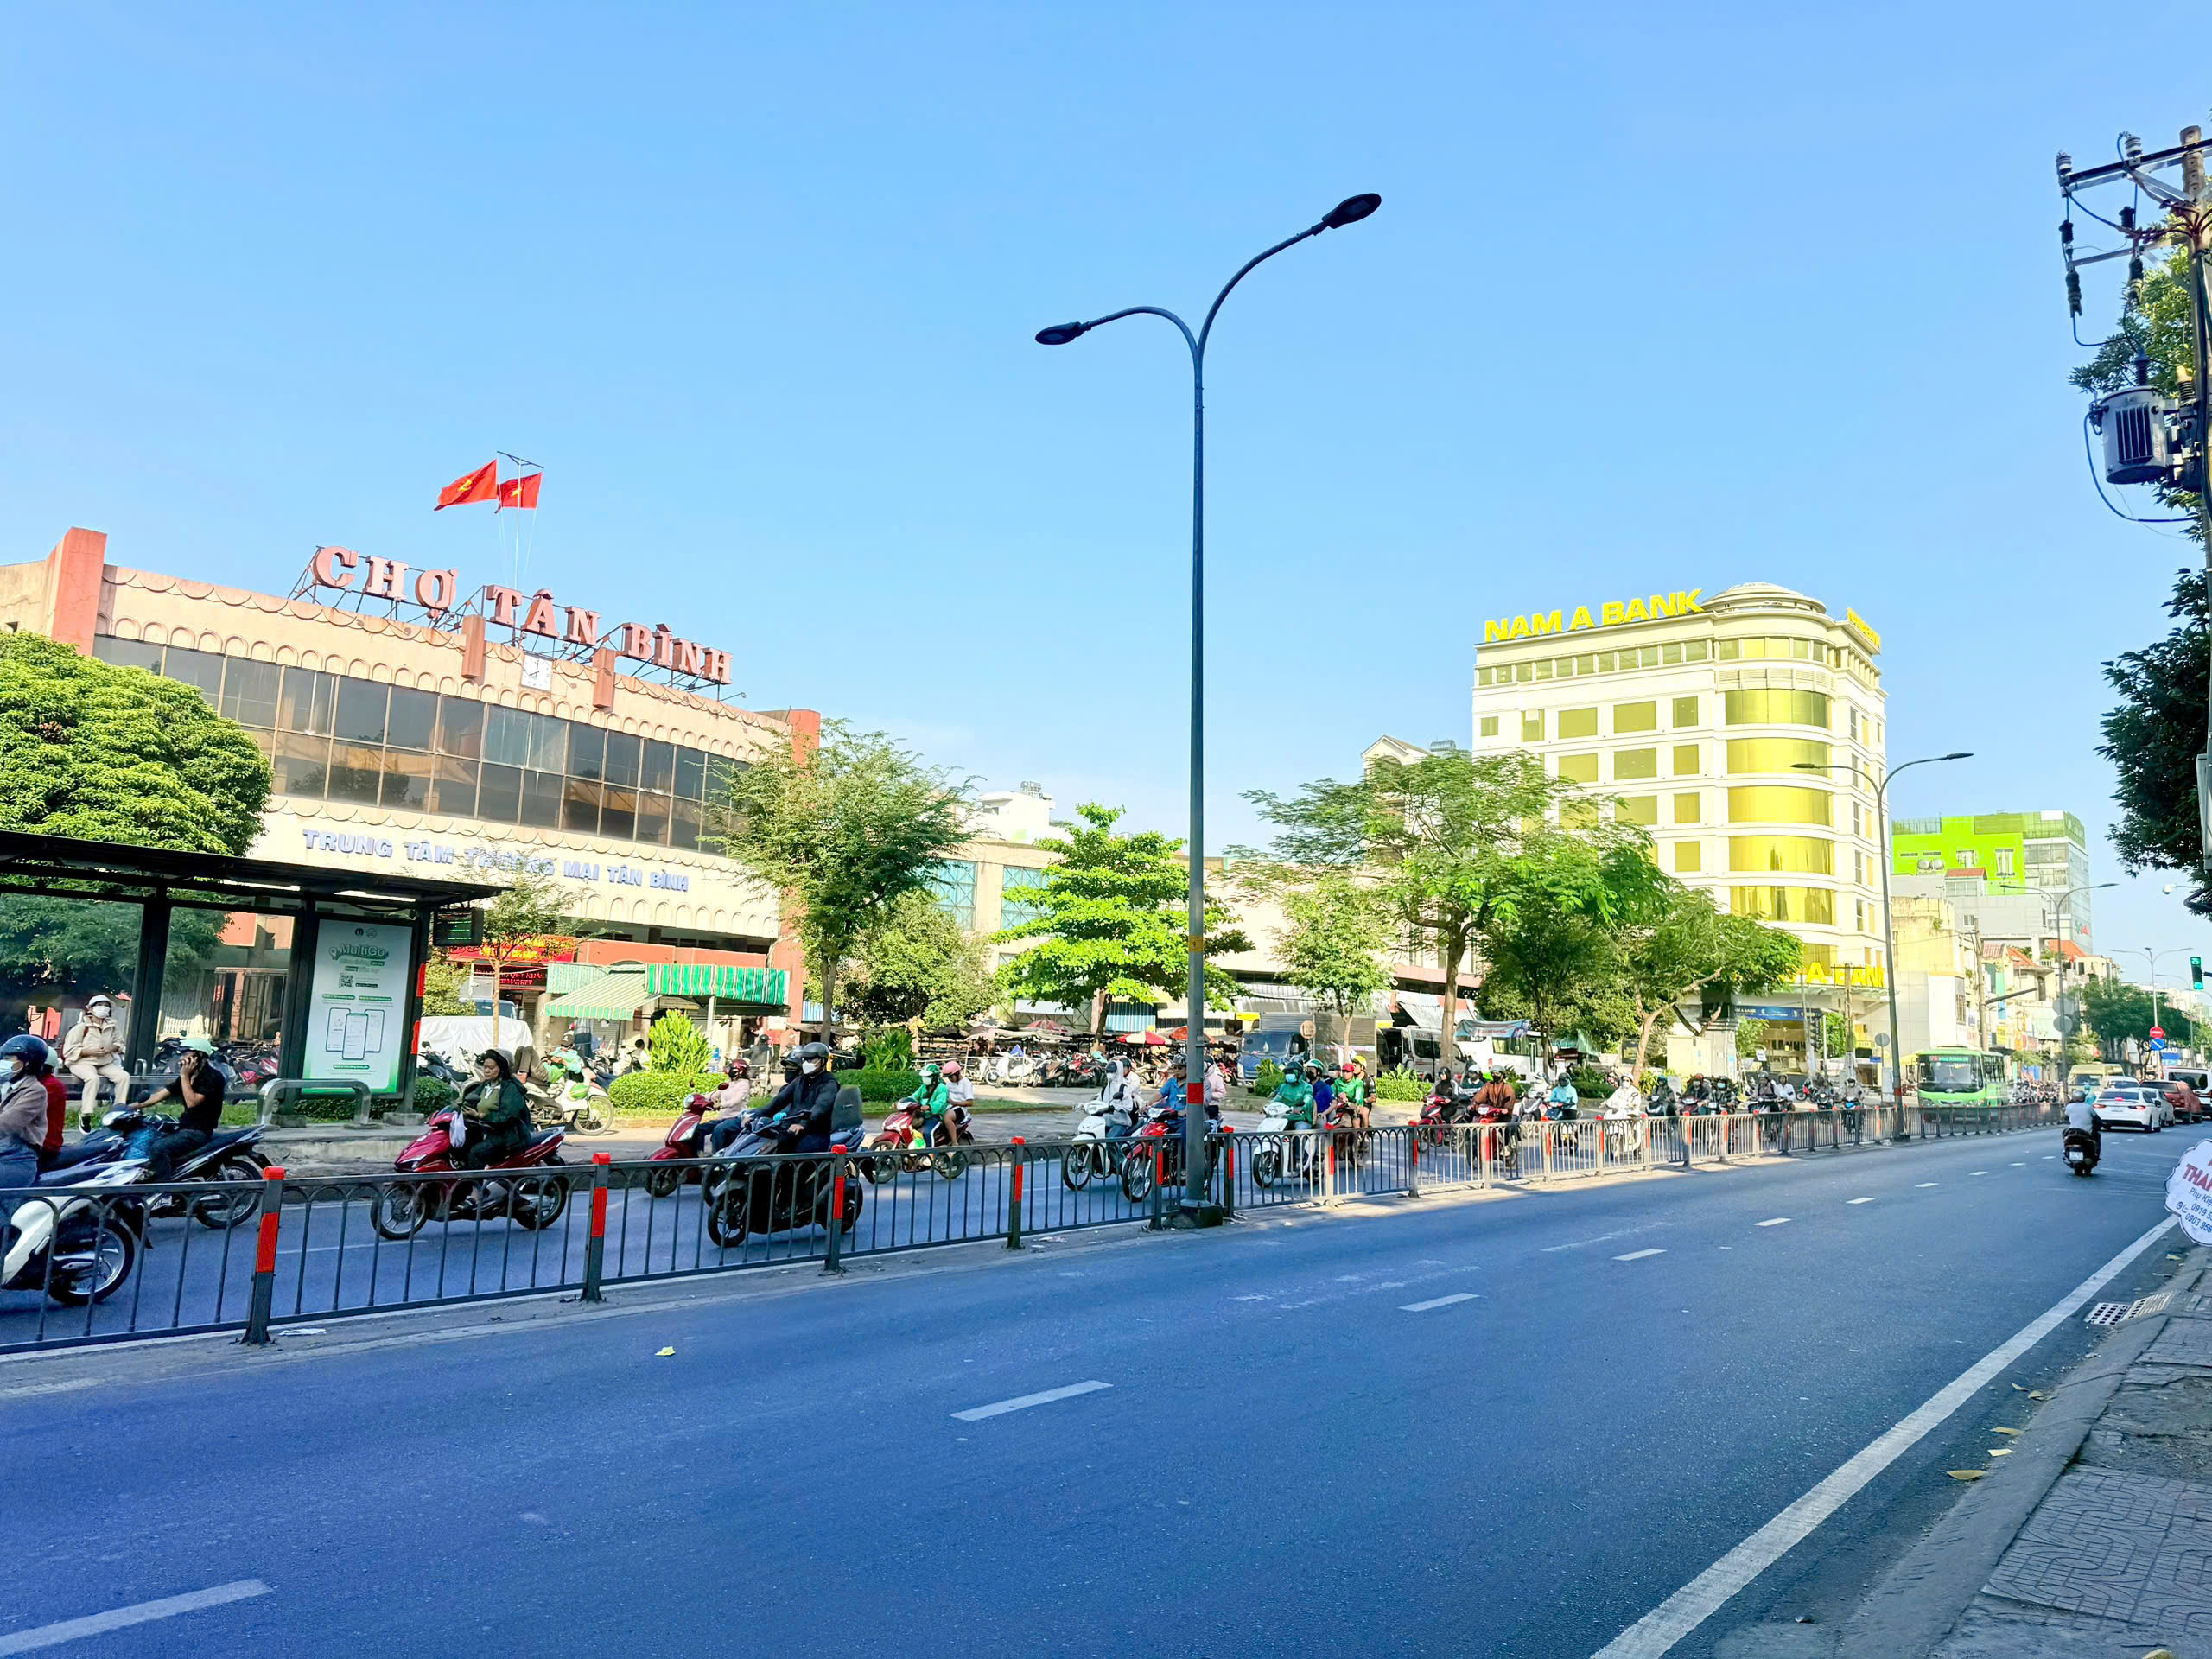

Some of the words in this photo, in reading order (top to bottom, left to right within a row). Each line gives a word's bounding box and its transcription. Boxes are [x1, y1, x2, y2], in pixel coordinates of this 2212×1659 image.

[312, 546, 459, 618] CHỢ
[486, 584, 601, 646] TÂN
[621, 622, 733, 684] BÌNH
[1484, 610, 1562, 643] NAM
[1569, 606, 1595, 631] A
[1602, 588, 1705, 627] BANK
[303, 830, 393, 857] TRUNG
[404, 840, 454, 864] TÂM
[607, 865, 643, 886] TÂN
[650, 868, 690, 892] BÌNH
[340, 943, 386, 957] MultiGo
[1806, 962, 1827, 985] A
[2201, 1193, 2212, 1206] Kiệ
[2185, 1212, 2201, 1226] 0903
[2191, 1203, 2207, 1217] 0919
